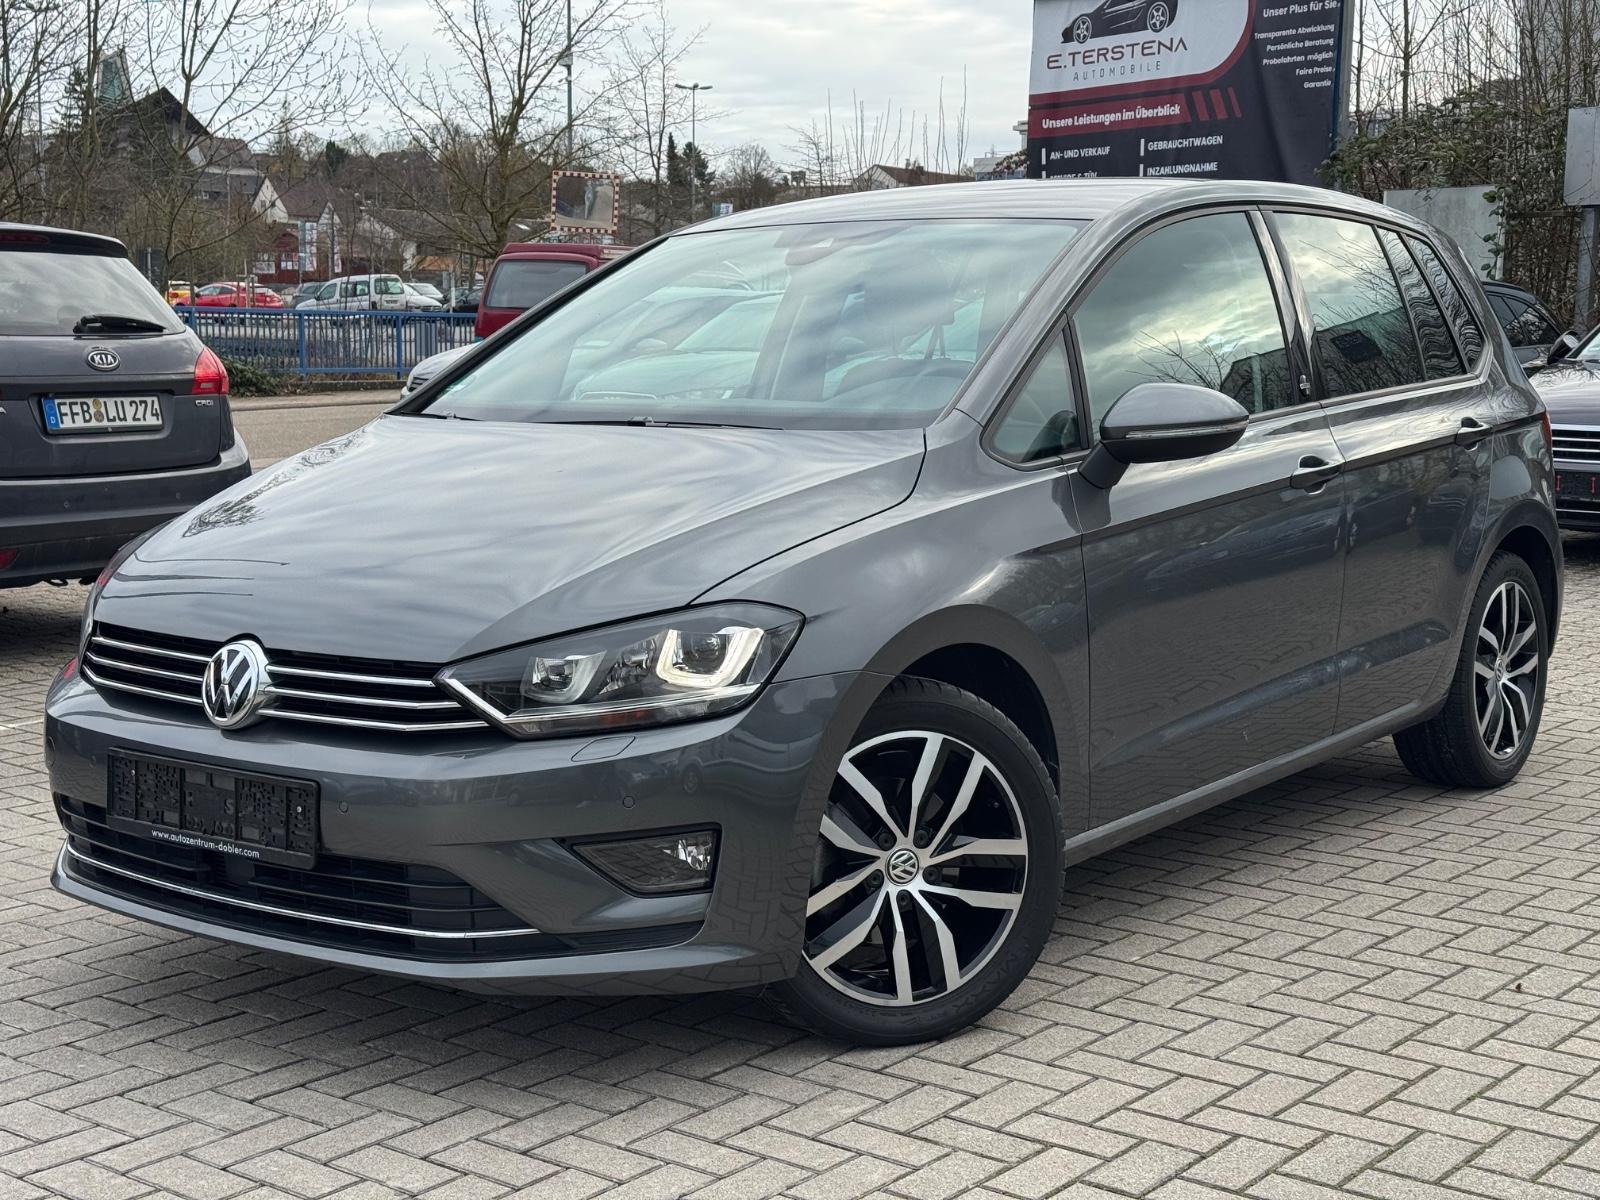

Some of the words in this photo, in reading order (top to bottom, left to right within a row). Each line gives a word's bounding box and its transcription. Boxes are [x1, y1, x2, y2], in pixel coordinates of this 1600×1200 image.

[1263, 8, 1288, 17] Unser
[1289, 4, 1308, 14] Plus
[1309, 1, 1323, 12] für
[1254, 29, 1297, 39] Transparente
[1297, 24, 1335, 33] Abwicklung
[1266, 42, 1304, 52] Persönliche
[1304, 38, 1334, 47] Beratung
[1047, 37, 1188, 70] E.TERSTENA
[1262, 55, 1305, 65] Probefahrten
[1307, 51, 1333, 62] möglich
[1073, 60, 1161, 82] AUTOMOBILE
[1295, 67, 1312, 76] Faire
[1303, 79, 1332, 89] Garantie
[1042, 117, 1073, 129] Unsere
[1074, 112, 1121, 126] Leistungen
[1122, 109, 1134, 120] im
[1135, 104, 1181, 119] Überblick
[1147, 135, 1223, 151] GEBRAUCHTWAGEN
[1049, 151, 1063, 161] AN-
[1063, 149, 1079, 159] UND
[1079, 146, 1111, 157] VERKAUF
[1147, 162, 1219, 176] INZAHLUNGNAHME
[93, 354, 115, 365] KIA
[50, 416, 56, 424] D
[56, 401, 93, 425] FFB
[103, 400, 128, 423] LU
[129, 399, 160, 422] 274
[151, 829, 261, 860] www.autozentrum-dobler.com
